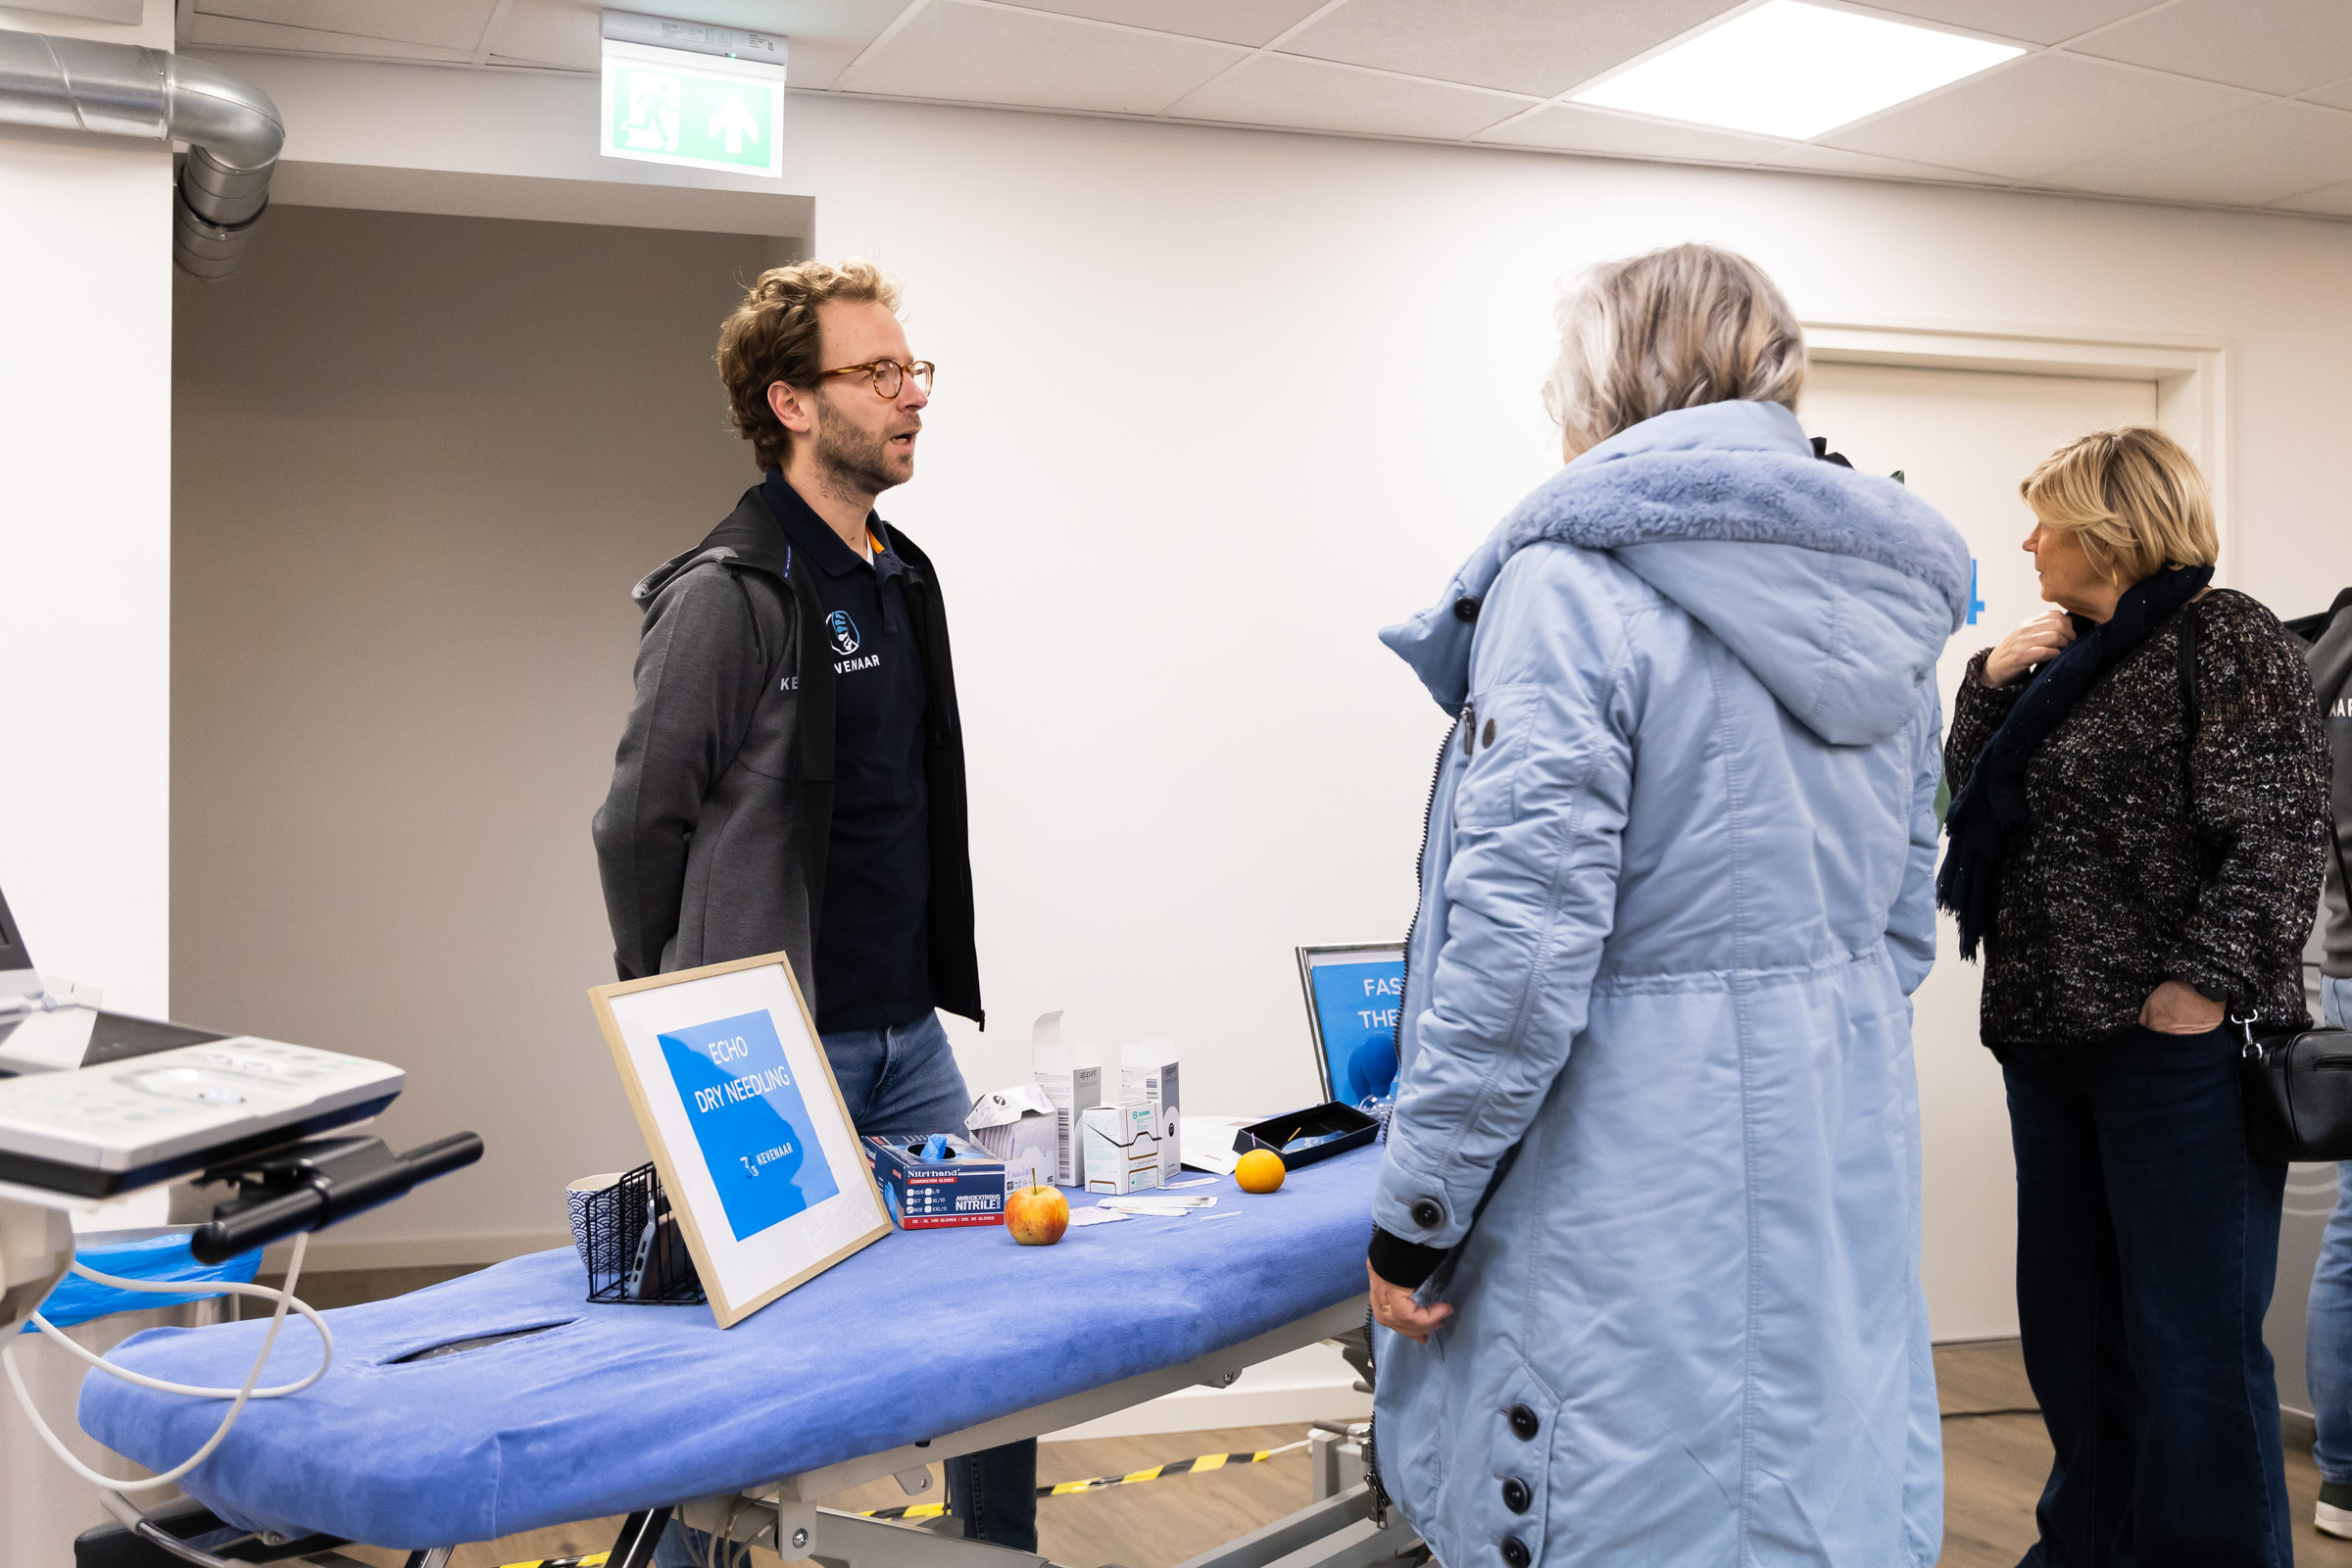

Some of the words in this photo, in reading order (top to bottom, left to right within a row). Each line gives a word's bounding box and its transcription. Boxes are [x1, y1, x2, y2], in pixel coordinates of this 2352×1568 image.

[834, 655, 880, 674] VENAAR
[780, 676, 799, 691] KE
[1363, 977, 1401, 997] FAS
[1357, 1008, 1398, 1029] THE
[708, 1036, 749, 1065] ECHO
[694, 1084, 725, 1113] DRY
[723, 1065, 791, 1104] NEEDLING
[756, 1142, 794, 1166] KEVENAAR
[955, 1200, 997, 1211] NITRILE
